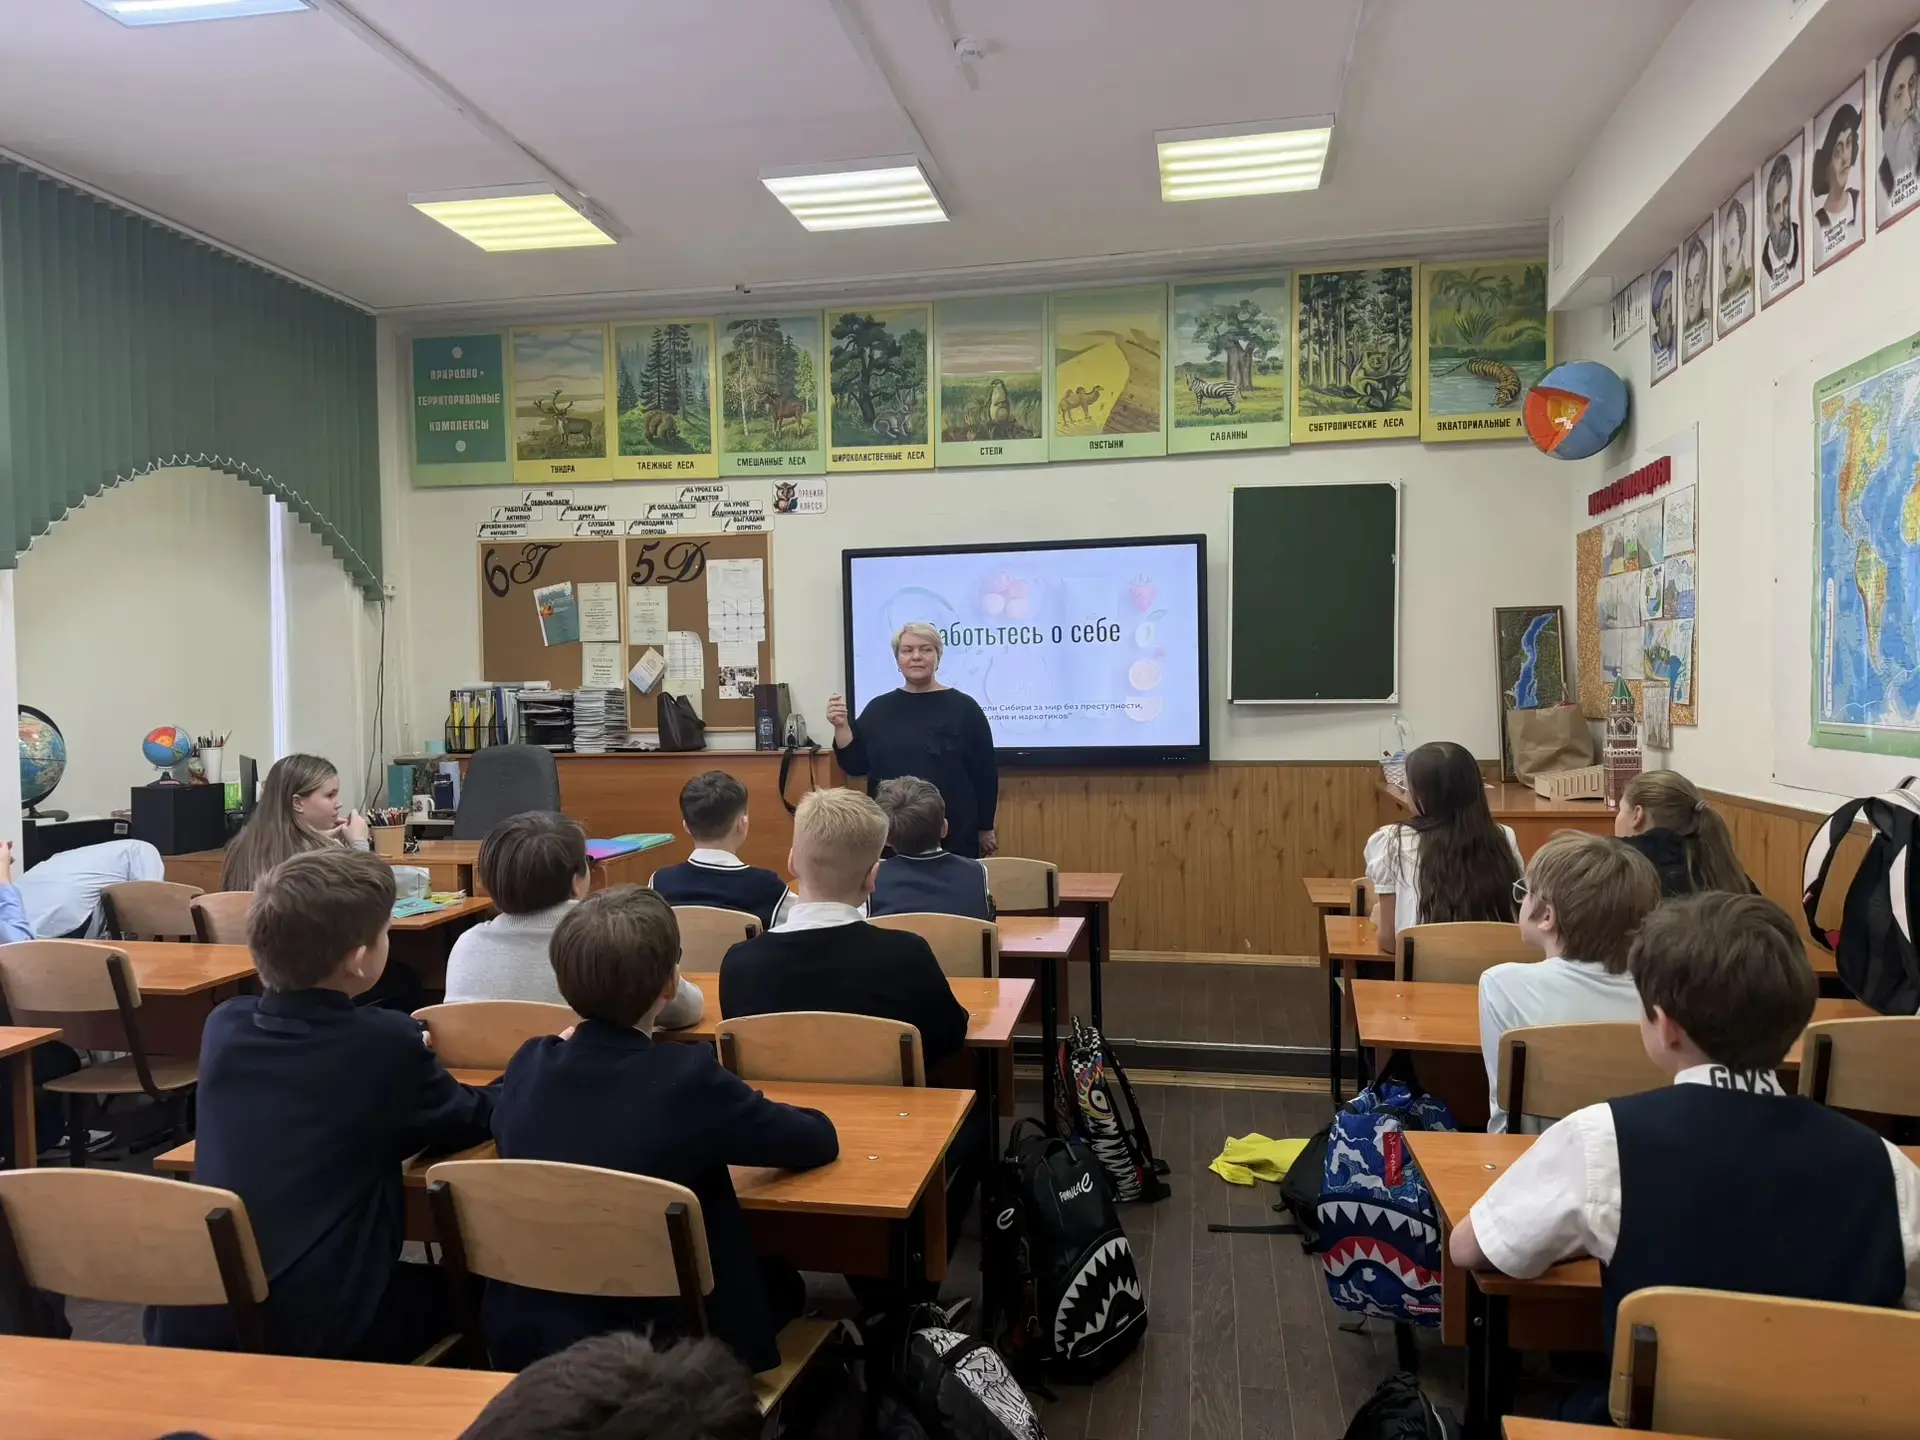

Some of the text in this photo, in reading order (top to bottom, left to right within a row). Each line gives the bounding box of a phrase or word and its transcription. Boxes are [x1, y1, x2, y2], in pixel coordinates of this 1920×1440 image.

[417, 393, 500, 406] ТЕРРИТОРИАЛЬНЫЕ
[429, 419, 489, 431] КОМПЛЕКСЫ
[1308, 418, 1404, 432] СУБТРОПИЧЕСКИЕ ЛЕСА
[1437, 418, 1511, 431] ЭКВАТОРИАЛЬНЫЕ
[1210, 430, 1248, 441] САВАННЫ
[1089, 440, 1124, 450] ПУСТЫНИ
[832, 450, 925, 463] ШИРОКОЛИСТВЕННЫЕ ЛЕСА
[980, 447, 1003, 456] СТЕПИ
[637, 460, 694, 470] ТАЕЖНЫЕ ЛЕСА
[736, 456, 806, 467] СМЕШАННЫЕ ЛЕСА
[550, 465, 575, 474] ТУНДРА
[1587, 455, 1671, 517] ИНФОРМАЦИЯ
[930, 617, 1120, 647] аботьтесь о себе
[999, 704, 1032, 712] Сибири
[1045, 704, 1062, 712] мир
[1064, 703, 1078, 711] без
[1080, 702, 1143, 712] преступности,
